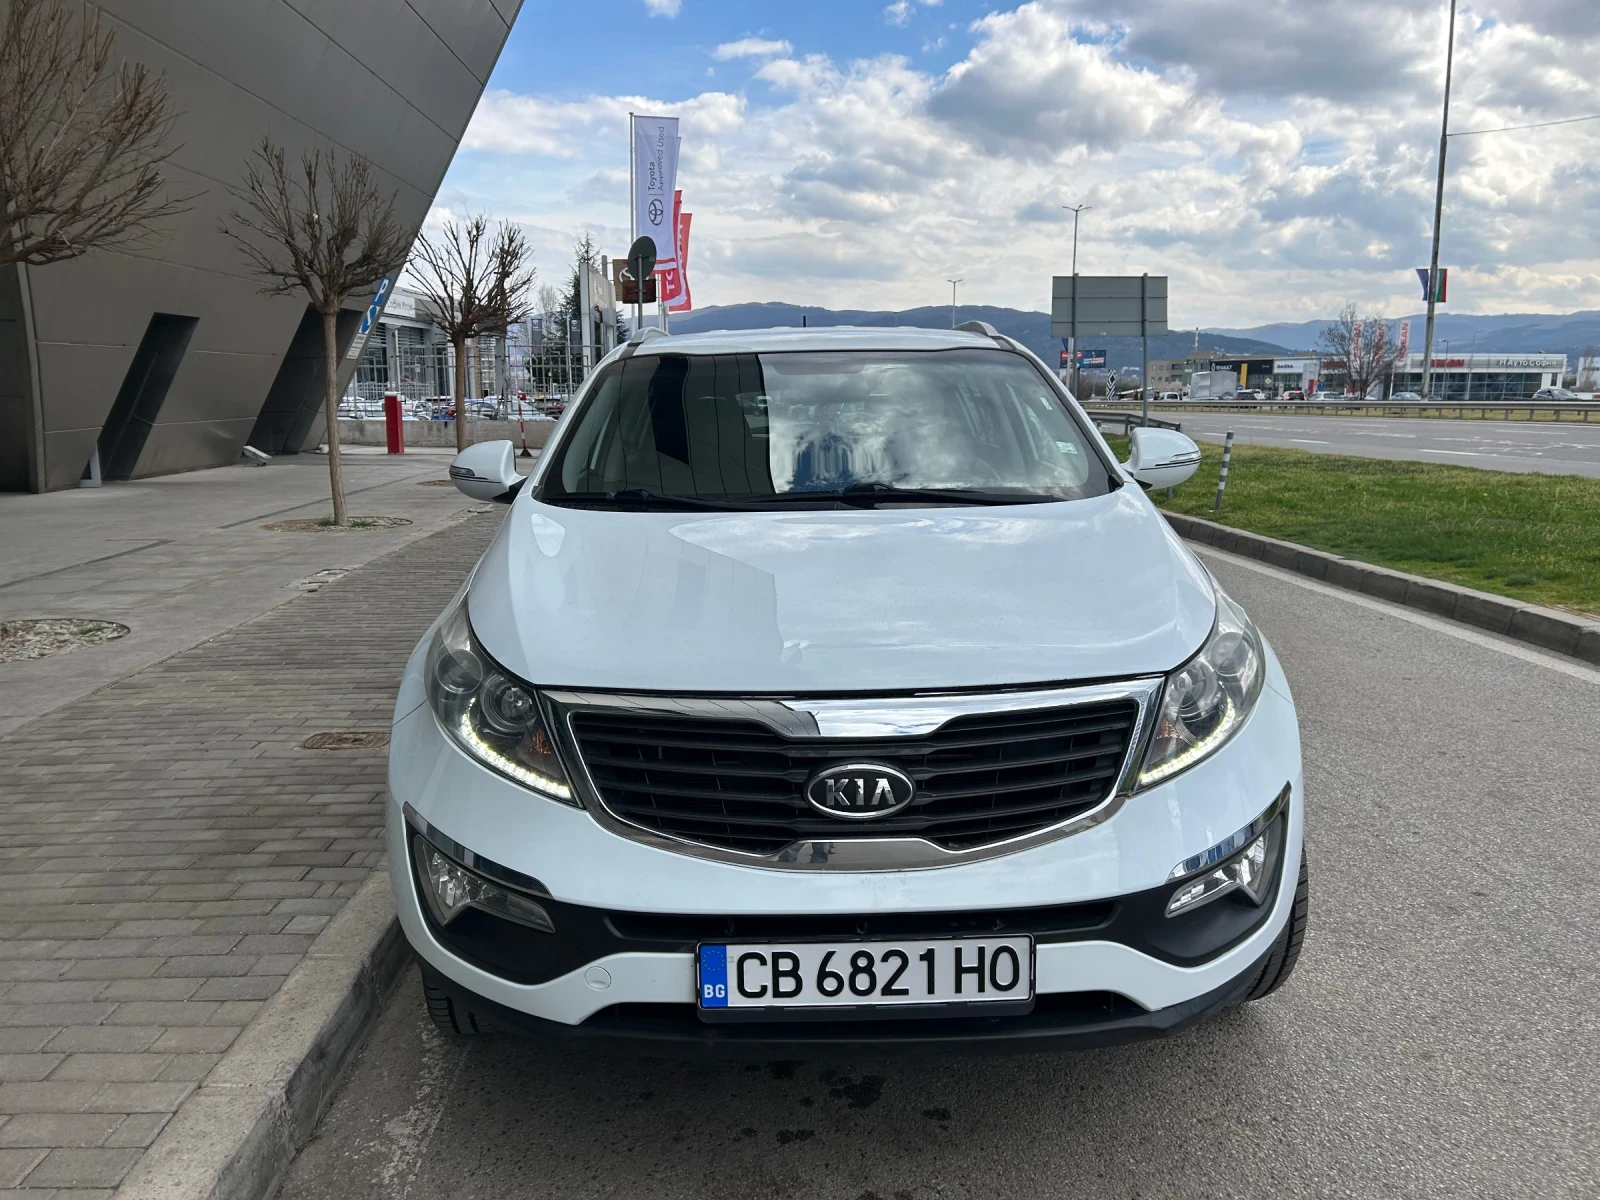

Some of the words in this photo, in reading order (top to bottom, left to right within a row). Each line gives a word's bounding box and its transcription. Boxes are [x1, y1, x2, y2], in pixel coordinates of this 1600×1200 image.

[656, 126, 665, 148] Used
[647, 161, 657, 192] Toyota
[656, 149, 664, 192] Approved
[1397, 322, 1409, 362] NISSAN
[1506, 359, 1528, 367] Ауто
[1529, 359, 1557, 367] София
[824, 778, 897, 806] KIA
[736, 951, 803, 999] CB
[817, 948, 935, 997] 6821
[954, 945, 1020, 994] HO
[704, 985, 725, 998] BG
